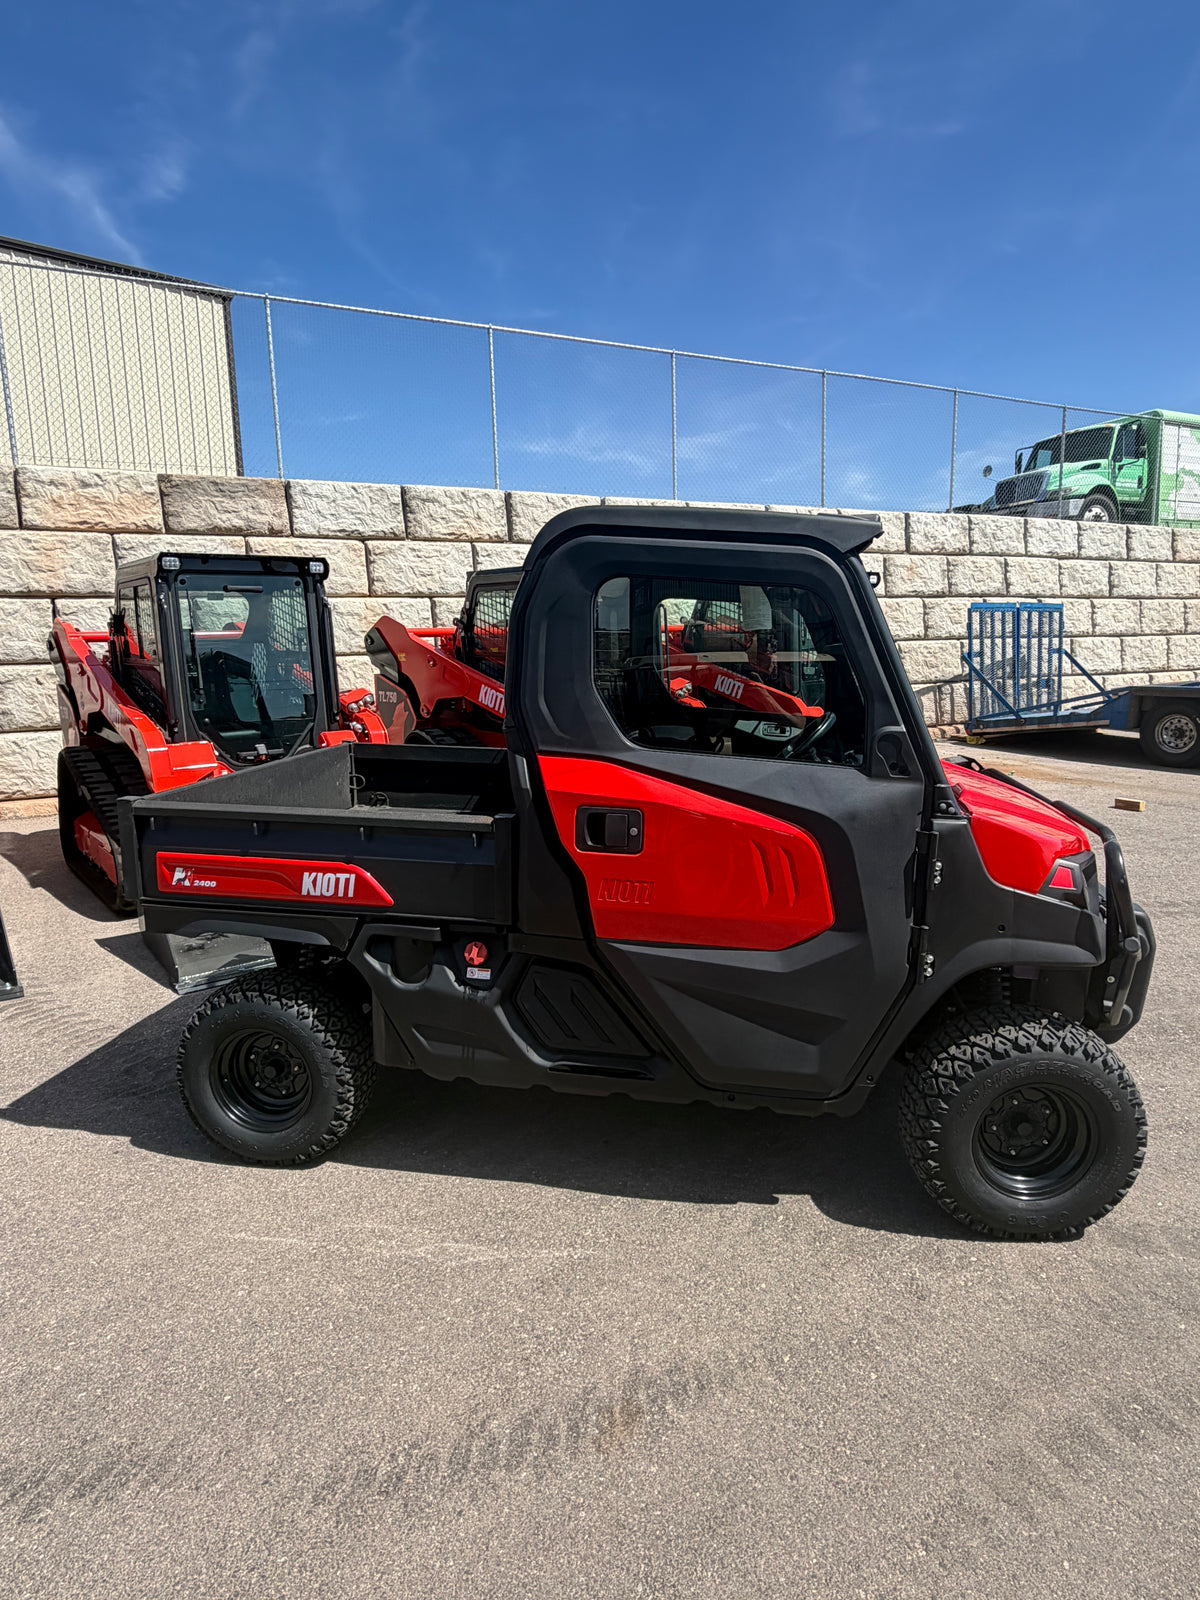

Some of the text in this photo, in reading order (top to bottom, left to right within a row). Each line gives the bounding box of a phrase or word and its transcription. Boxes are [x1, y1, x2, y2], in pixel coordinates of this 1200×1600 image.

[379, 691, 397, 703] TL750
[478, 684, 505, 714] KIOTI
[714, 675, 744, 699] KIOTI
[193, 880, 217, 888] 2400
[301, 872, 356, 897] KIOTI
[597, 878, 655, 904] KIOTI
